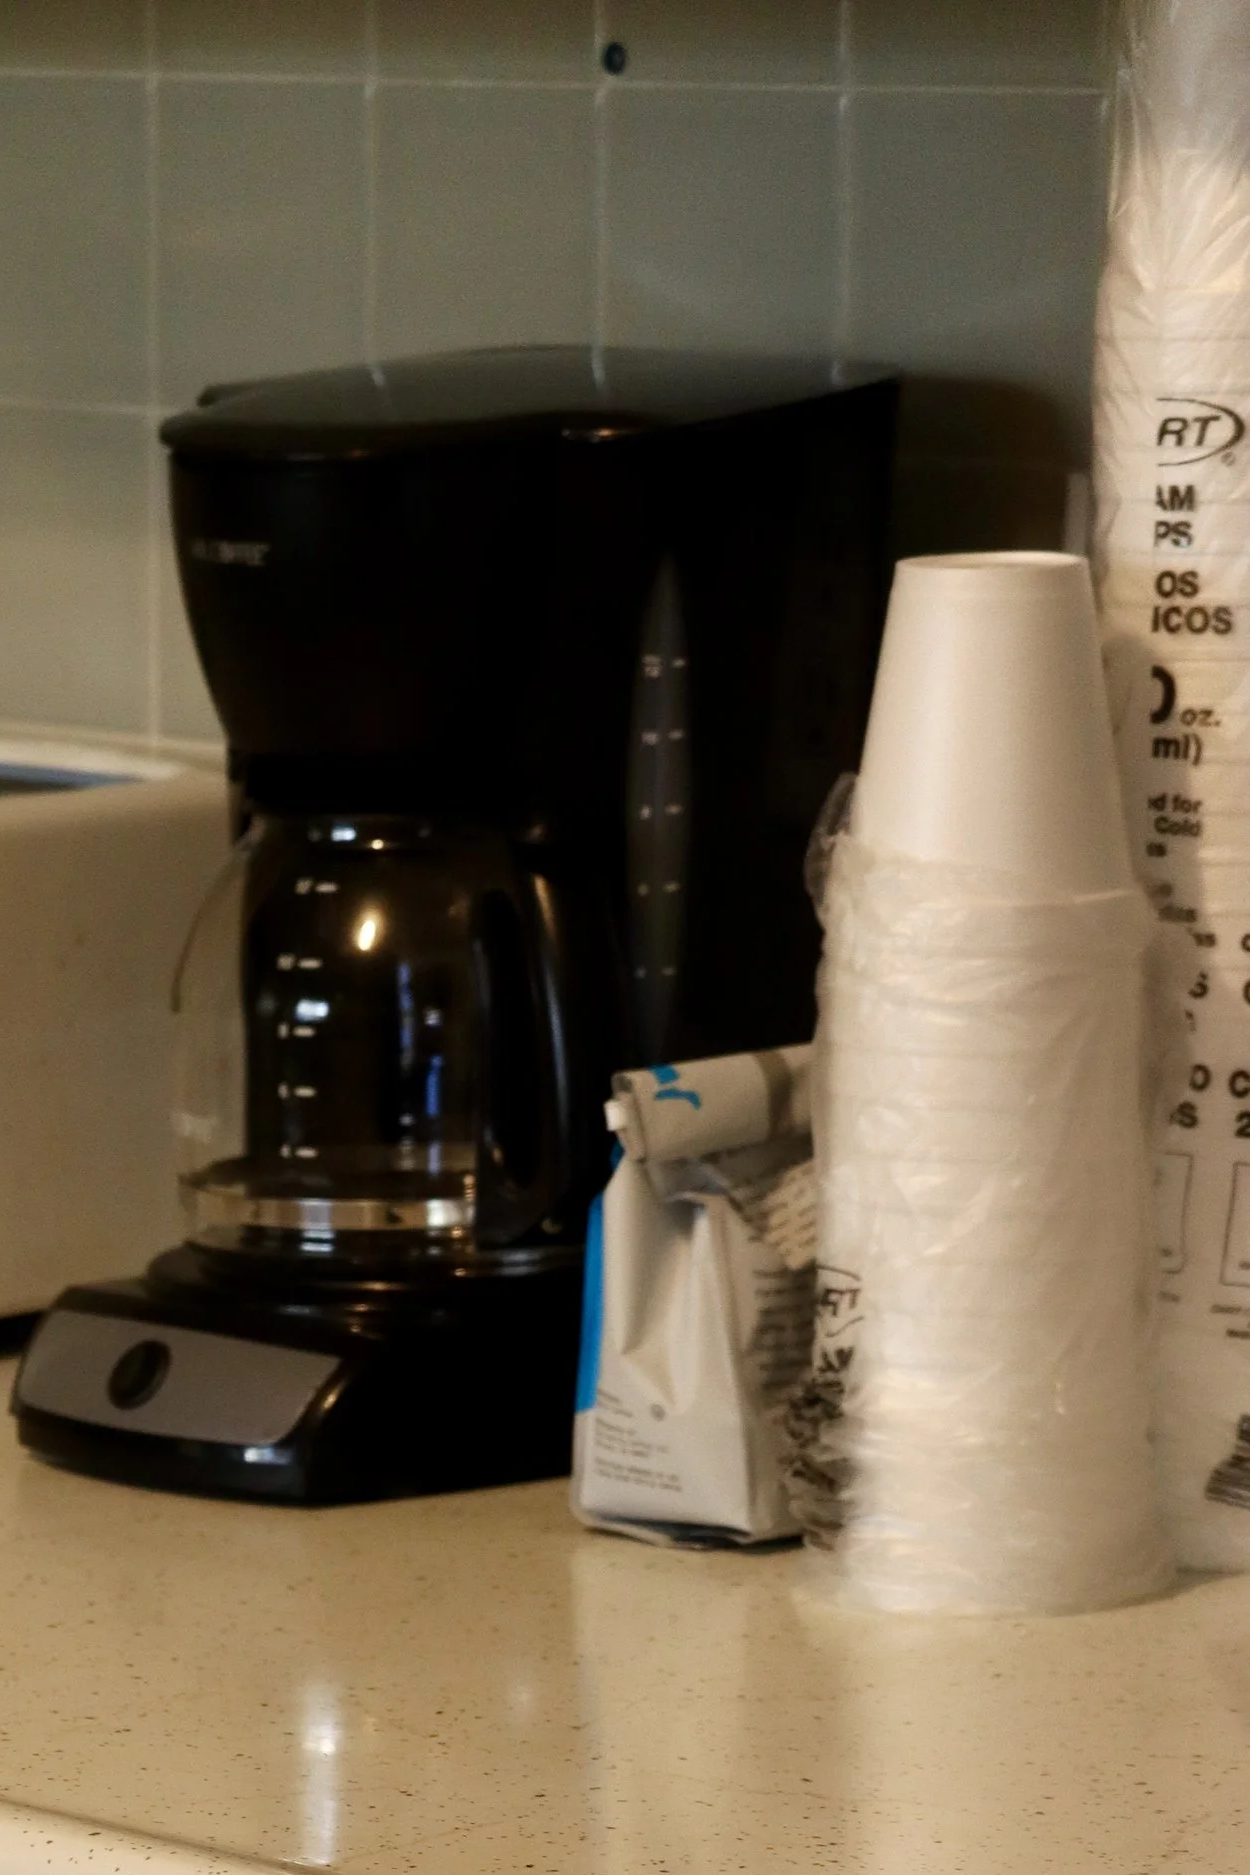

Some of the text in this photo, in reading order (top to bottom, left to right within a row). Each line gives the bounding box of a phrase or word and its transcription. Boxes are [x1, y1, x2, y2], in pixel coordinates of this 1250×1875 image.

[1155, 569, 1200, 598] OS
[1152, 605, 1233, 636] ICOS
[1180, 708, 1222, 728] oz.
